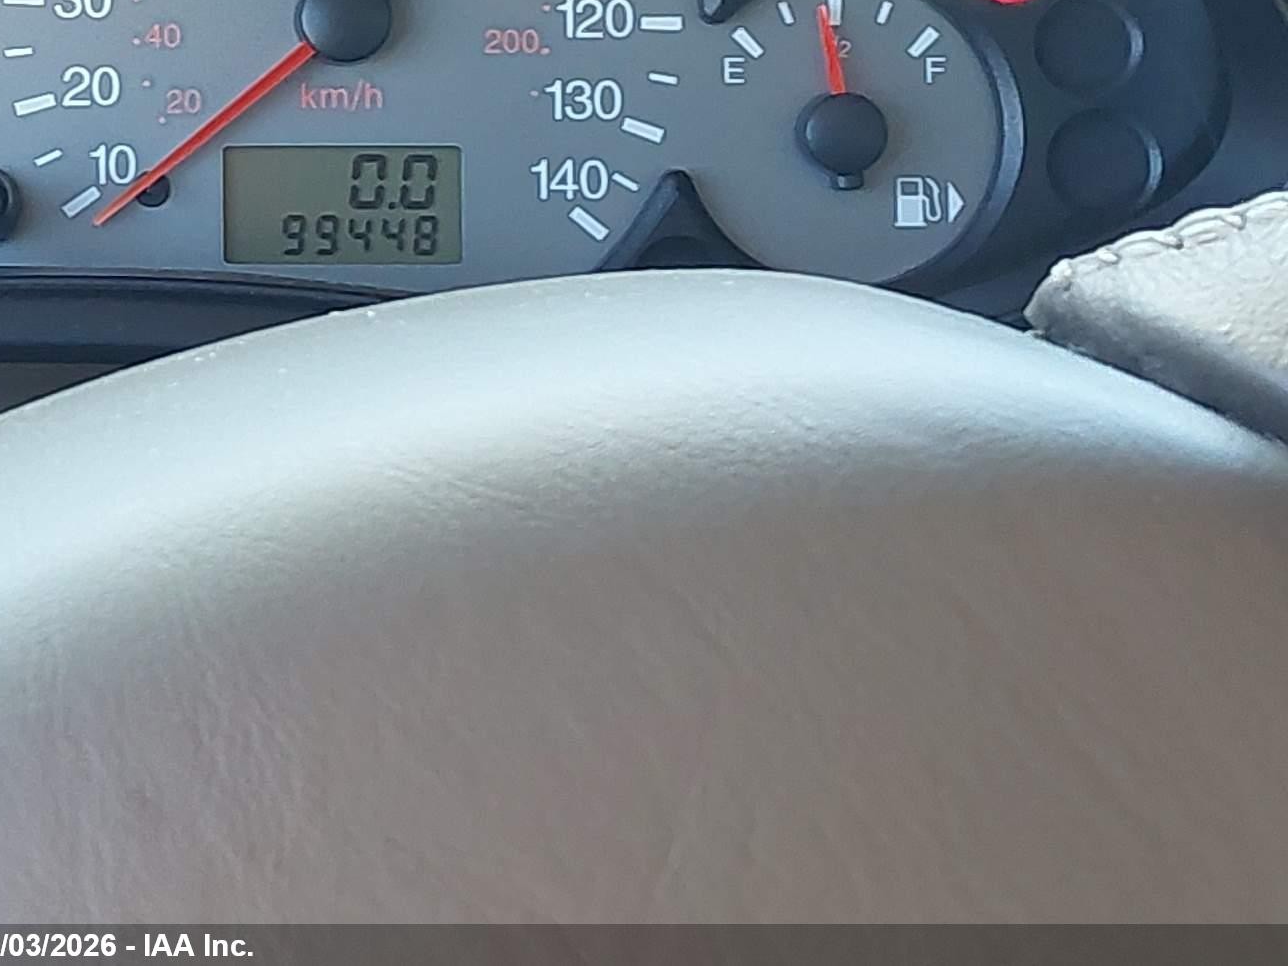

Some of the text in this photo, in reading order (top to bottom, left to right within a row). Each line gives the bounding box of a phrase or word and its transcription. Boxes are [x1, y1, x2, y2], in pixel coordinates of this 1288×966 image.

[145, 24, 181, 48] 40
[483, 30, 539, 54] 200
[61, 66, 120, 107] 20
[723, 56, 746, 85] E
[925, 56, 947, 84] F
[166, 89, 202, 114] 20
[300, 81, 384, 110] km/h
[545, 80, 622, 120] 130
[89, 144, 137, 185] 10
[349, 153, 438, 210] 0.0
[530, 158, 608, 200] 140
[282, 215, 439, 257] 99448
